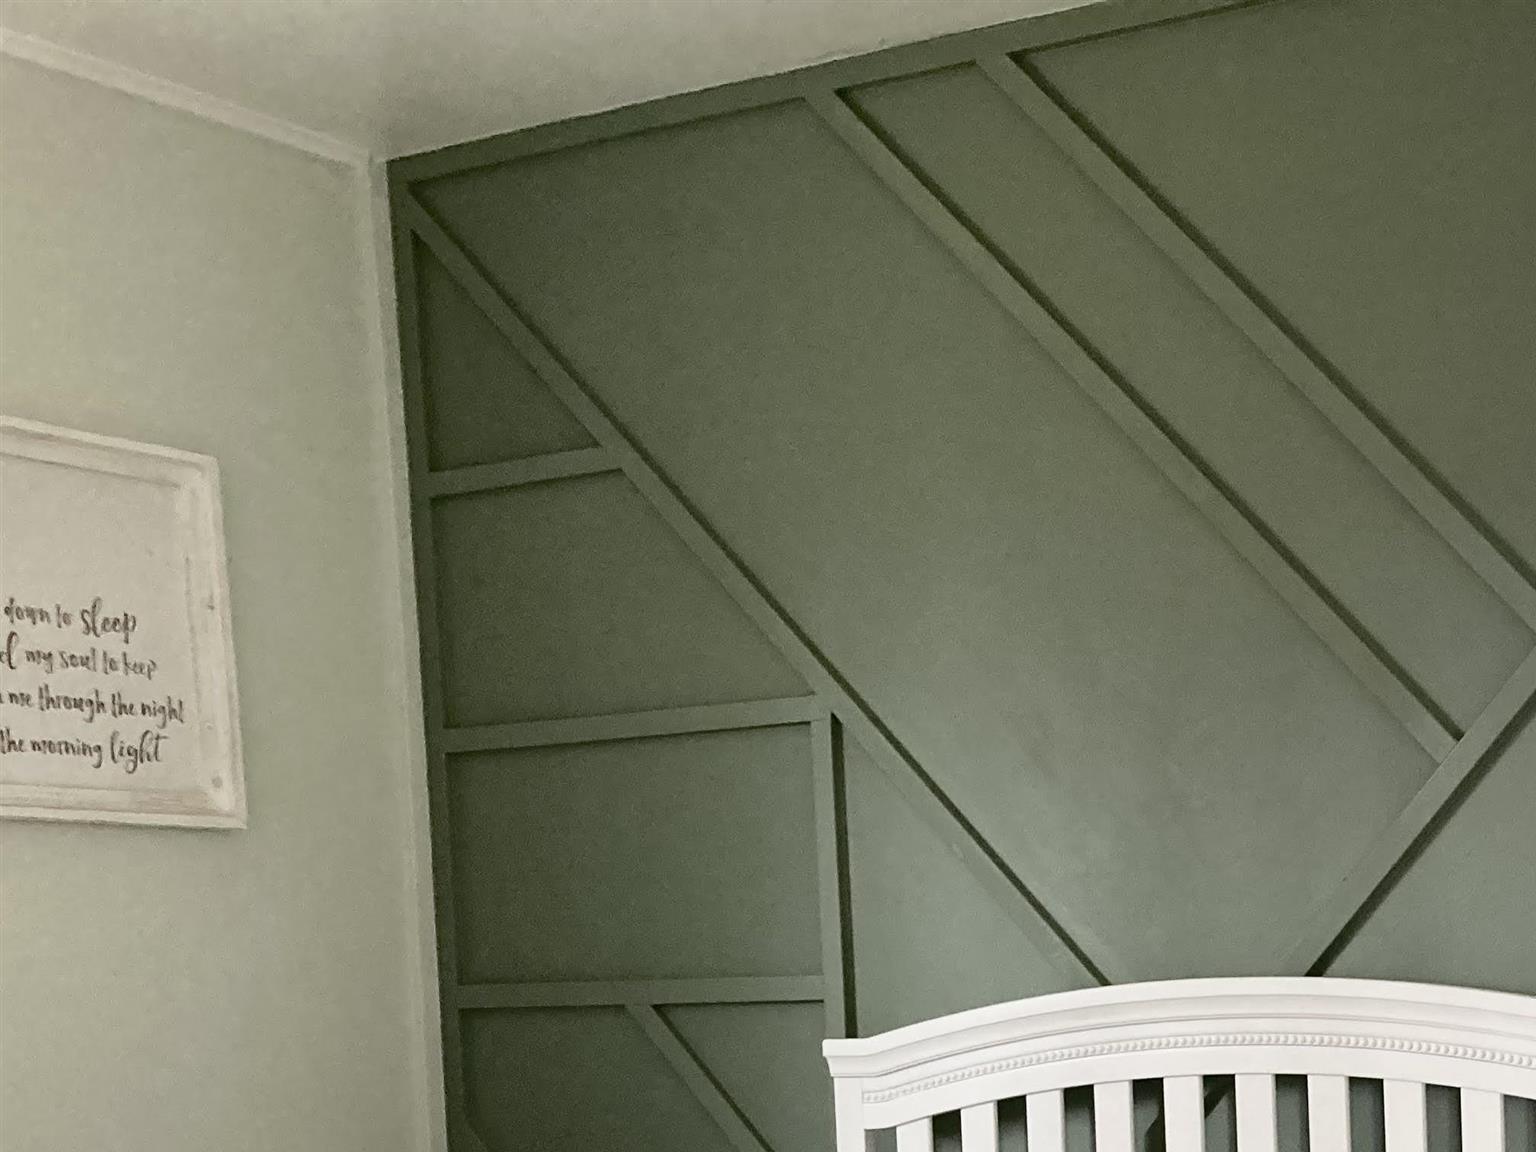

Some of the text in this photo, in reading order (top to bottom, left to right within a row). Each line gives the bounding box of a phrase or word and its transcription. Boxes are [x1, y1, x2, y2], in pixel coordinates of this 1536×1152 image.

[81, 596, 137, 645] sleep
[25, 649, 53, 674] my
[59, 647, 97, 672] soul
[38, 683, 107, 724] through
[111, 691, 137, 719] the
[141, 695, 184, 729] night
[30, 738, 103, 769] morning
[110, 730, 169, 775] light
